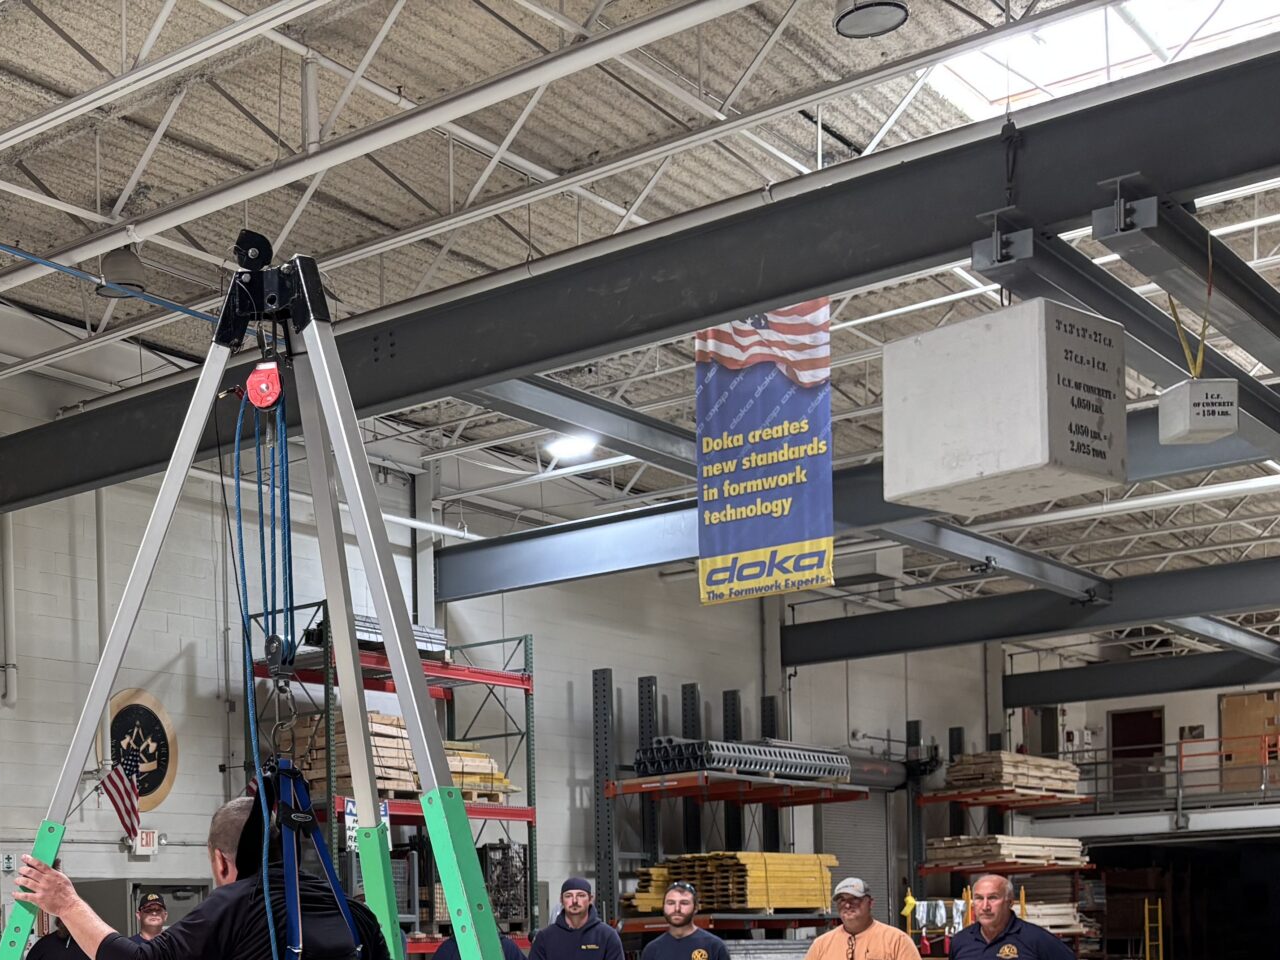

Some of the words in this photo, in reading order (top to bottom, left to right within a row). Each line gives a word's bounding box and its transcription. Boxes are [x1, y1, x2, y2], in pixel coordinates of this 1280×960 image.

[1082, 382, 1112, 401] CONCRETE
[1070, 396, 1091, 412] 4,050
[1202, 409, 1216, 417] 150
[702, 431, 744, 453] Doka
[748, 418, 809, 444] creates
[1068, 421, 1089, 438] 4,050
[702, 458, 737, 477] new
[742, 437, 827, 470] standards
[703, 484, 718, 501] in
[723, 465, 807, 498] formwork
[704, 497, 792, 525] technology
[706, 549, 827, 587] doka
[706, 591, 725, 601] The
[728, 582, 781, 599] Formwork
[140, 831, 156, 848] EXIT
